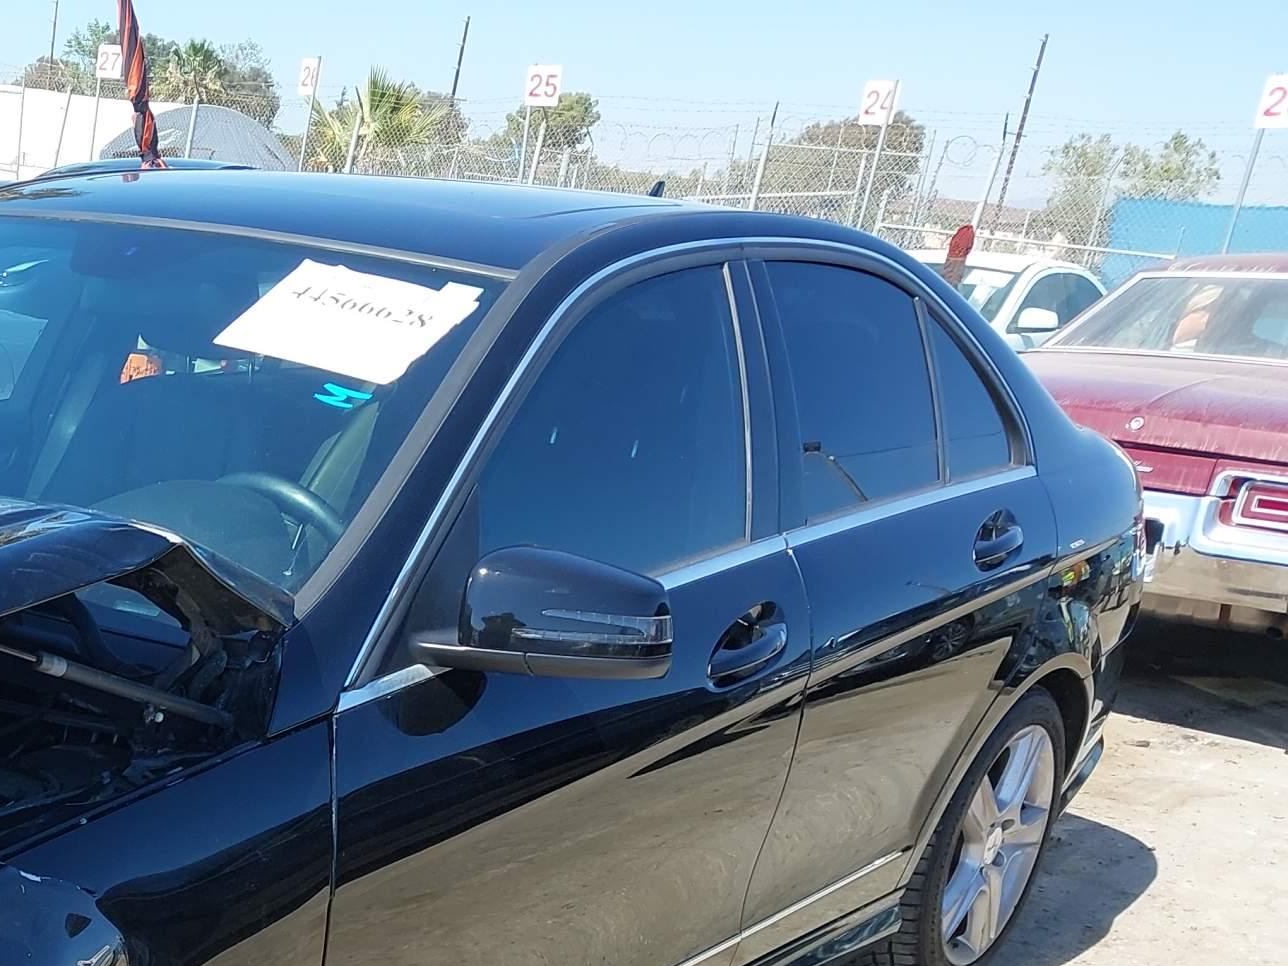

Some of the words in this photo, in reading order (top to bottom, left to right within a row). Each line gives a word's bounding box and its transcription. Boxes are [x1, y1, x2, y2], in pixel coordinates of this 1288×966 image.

[99, 51, 121, 70] 27
[528, 74, 558, 98] 25
[1263, 86, 1288, 117] 2
